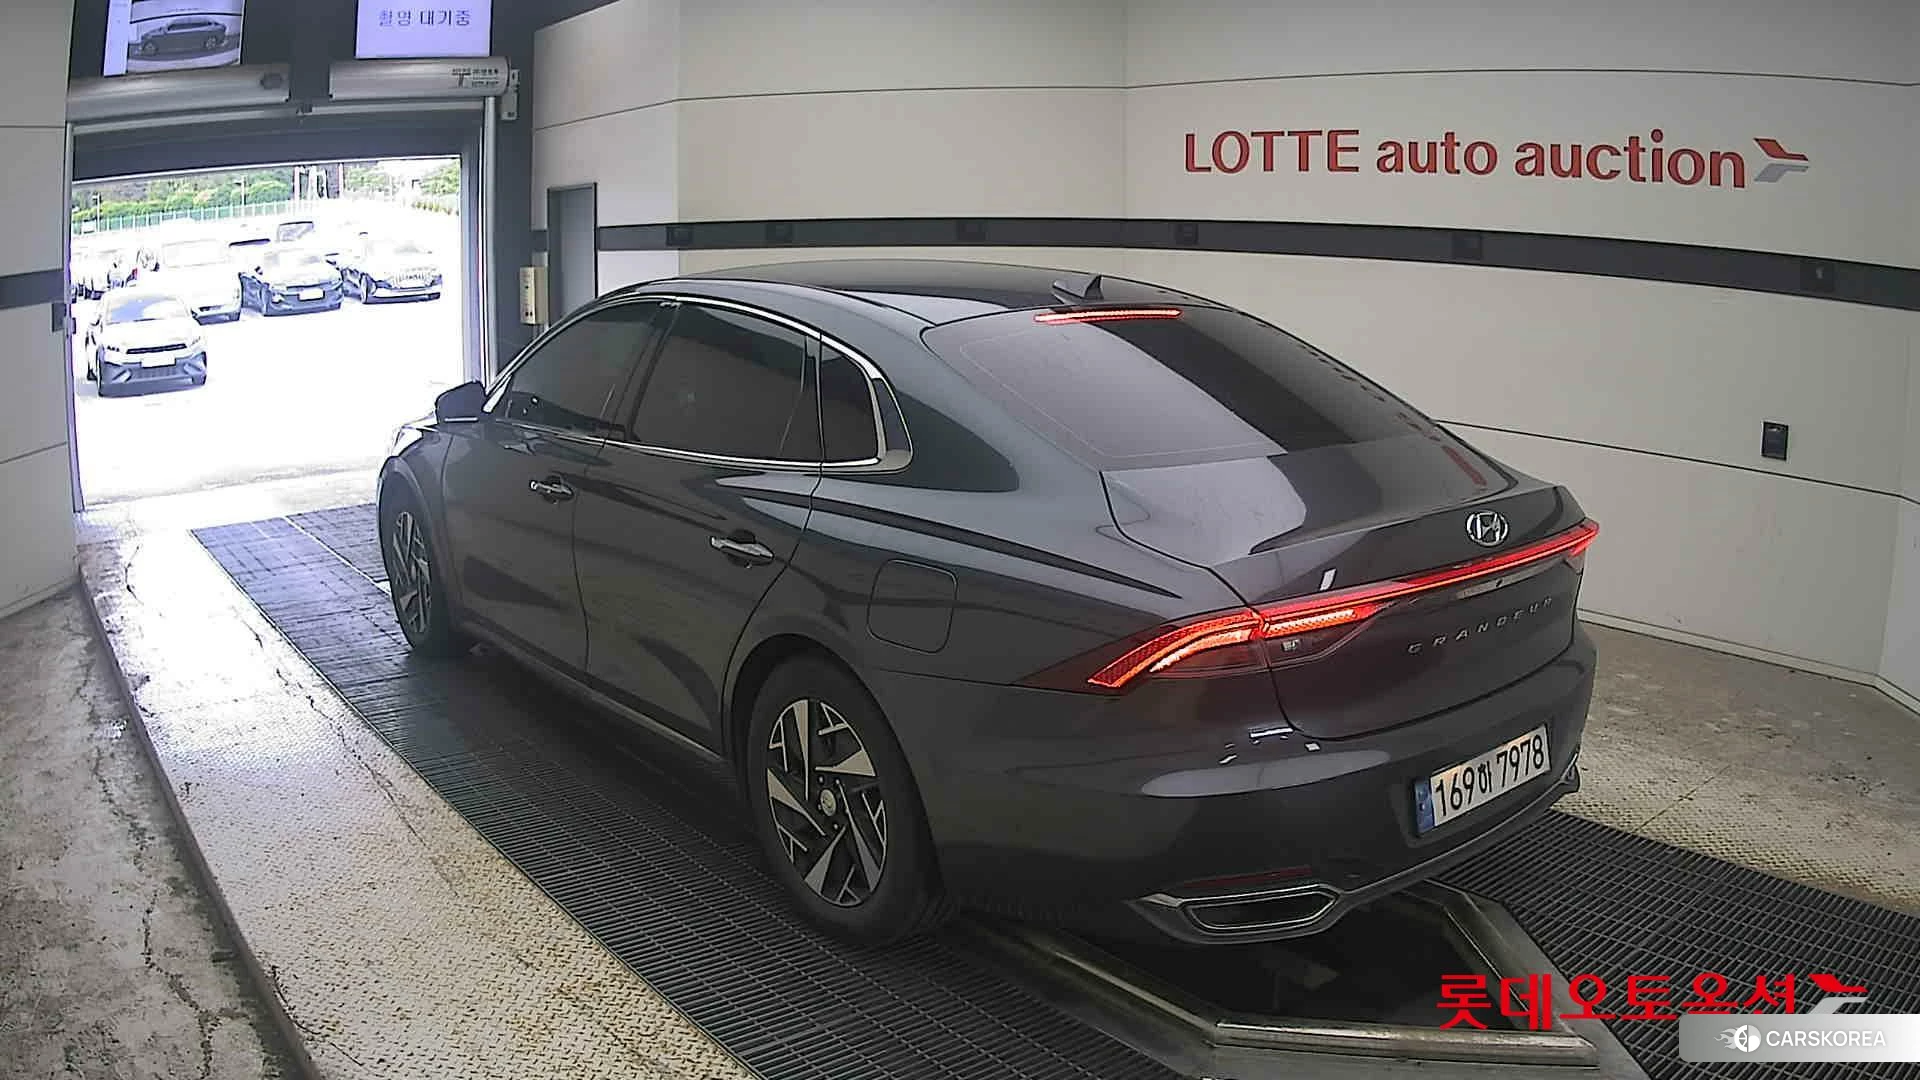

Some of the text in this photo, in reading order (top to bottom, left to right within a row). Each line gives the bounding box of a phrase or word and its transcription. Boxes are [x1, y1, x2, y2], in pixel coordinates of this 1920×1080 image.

[419, 9, 471, 27] 대기중
[1184, 129, 1746, 188] LOTTE auto auction
[1407, 596, 1553, 655] GRANDEUR
